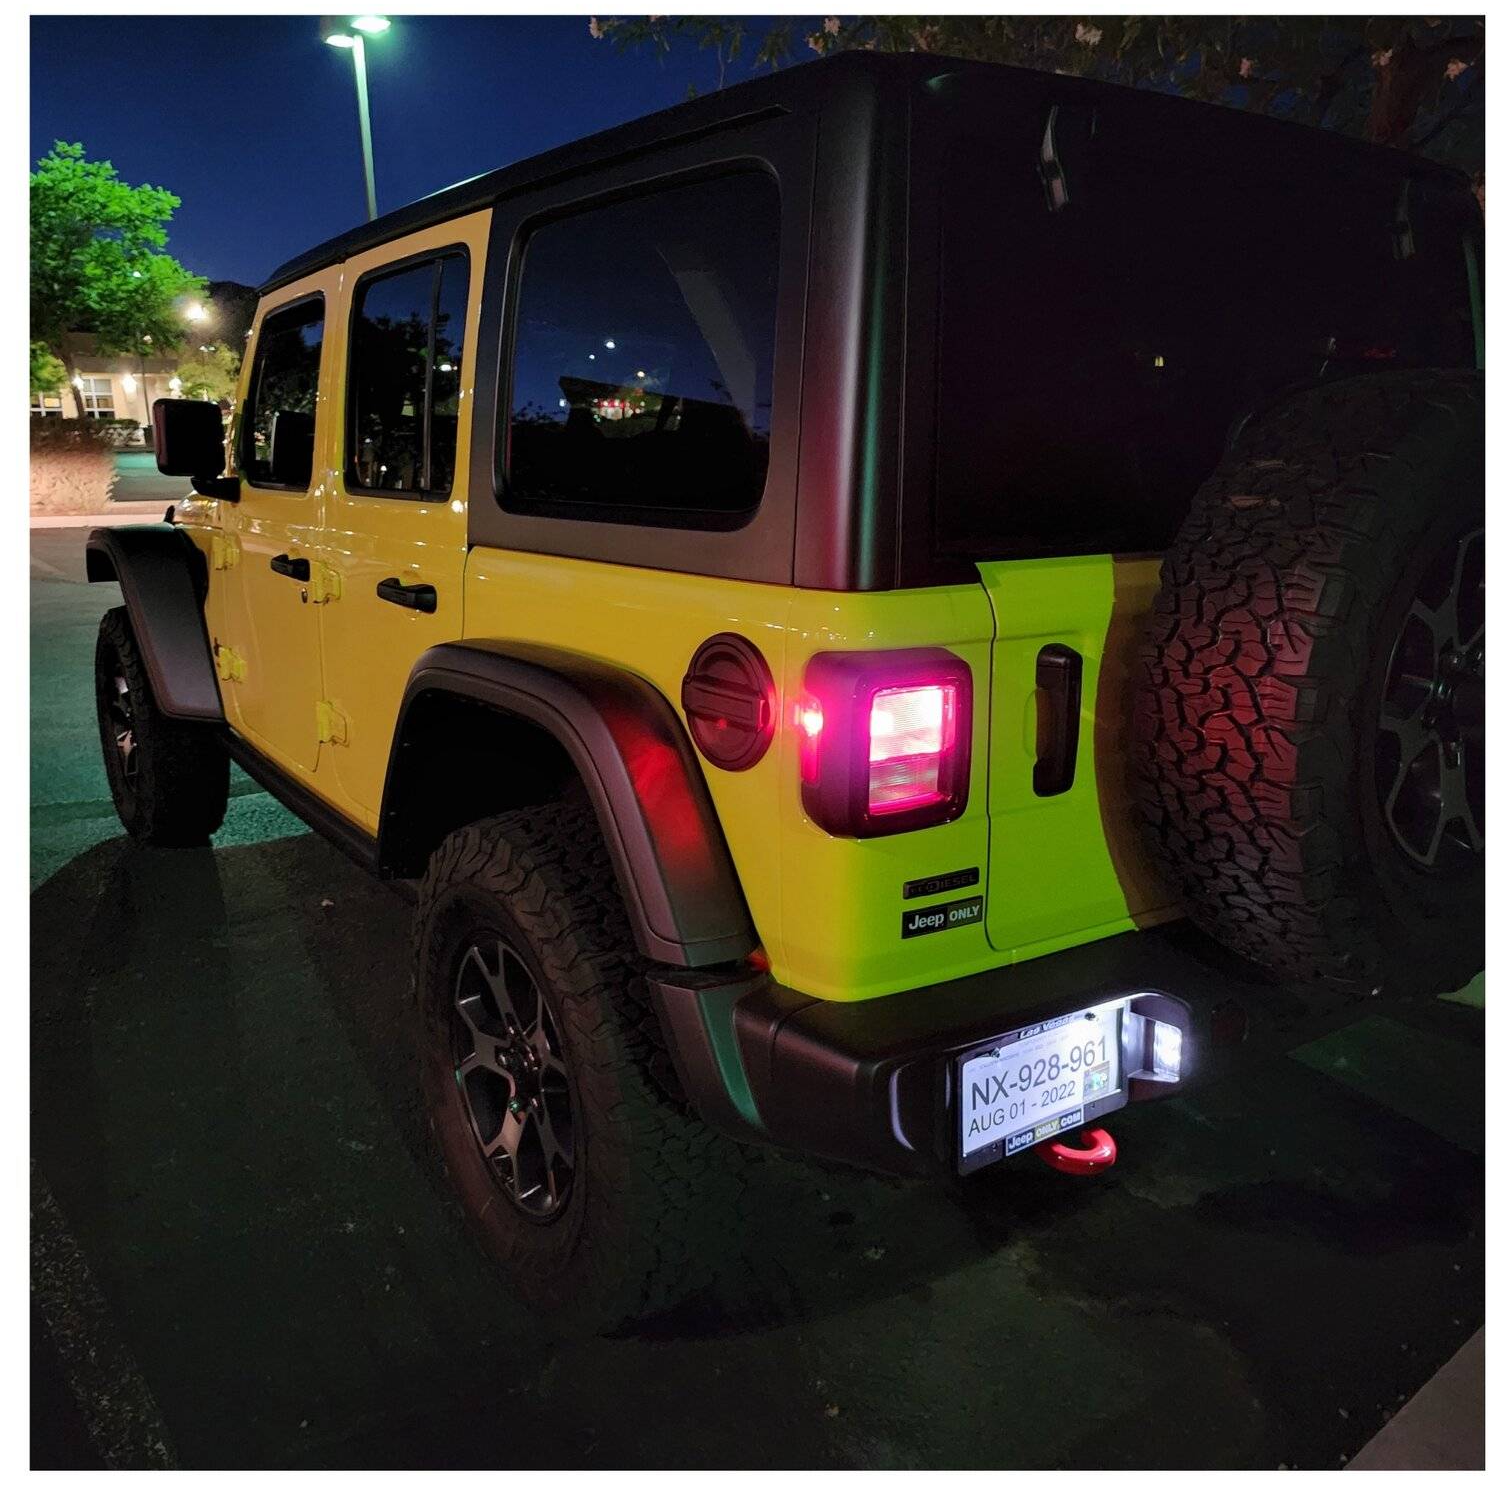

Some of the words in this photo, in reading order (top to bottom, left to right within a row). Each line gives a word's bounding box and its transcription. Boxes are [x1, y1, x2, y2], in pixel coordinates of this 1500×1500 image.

[908, 913, 945, 930] Jeep
[949, 905, 980, 922] ONLY
[971, 1035, 1106, 1111] NX-928-961
[968, 1108, 1005, 1138] AUG
[1009, 1099, 1026, 1120] 01
[1041, 1080, 1076, 1108] 2022
